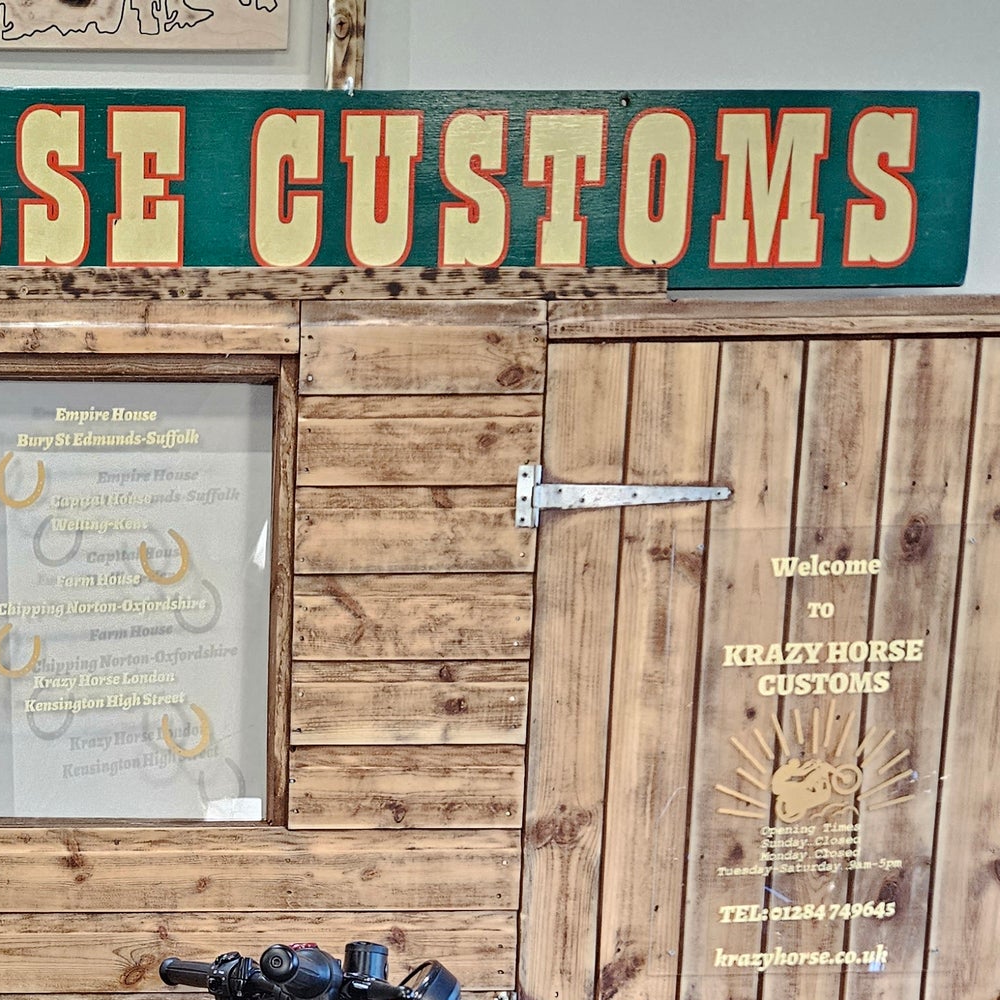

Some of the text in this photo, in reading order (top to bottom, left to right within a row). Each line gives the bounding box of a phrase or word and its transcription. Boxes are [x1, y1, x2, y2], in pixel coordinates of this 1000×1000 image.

[250, 107, 917, 269] CUSTOMS
[55, 407, 157, 421] Empire House
[17, 428, 199, 450] Bury St Edmunds-Suffolk
[771, 554, 881, 577] Welcome
[56, 572, 142, 588] Farm House
[67, 597, 206, 615] Norton-Oxfordshire
[807, 602, 834, 618] TO
[723, 639, 924, 667] KRAZY HORSE
[33, 671, 176, 690] Krazy Horse London
[758, 671, 891, 696] CUSTOMS
[25, 692, 186, 714] Kensington High Street
[761, 822, 861, 837] Opening Times
[829, 901, 896, 920] 749645
[714, 944, 888, 971] krazyhorse.co.uk
